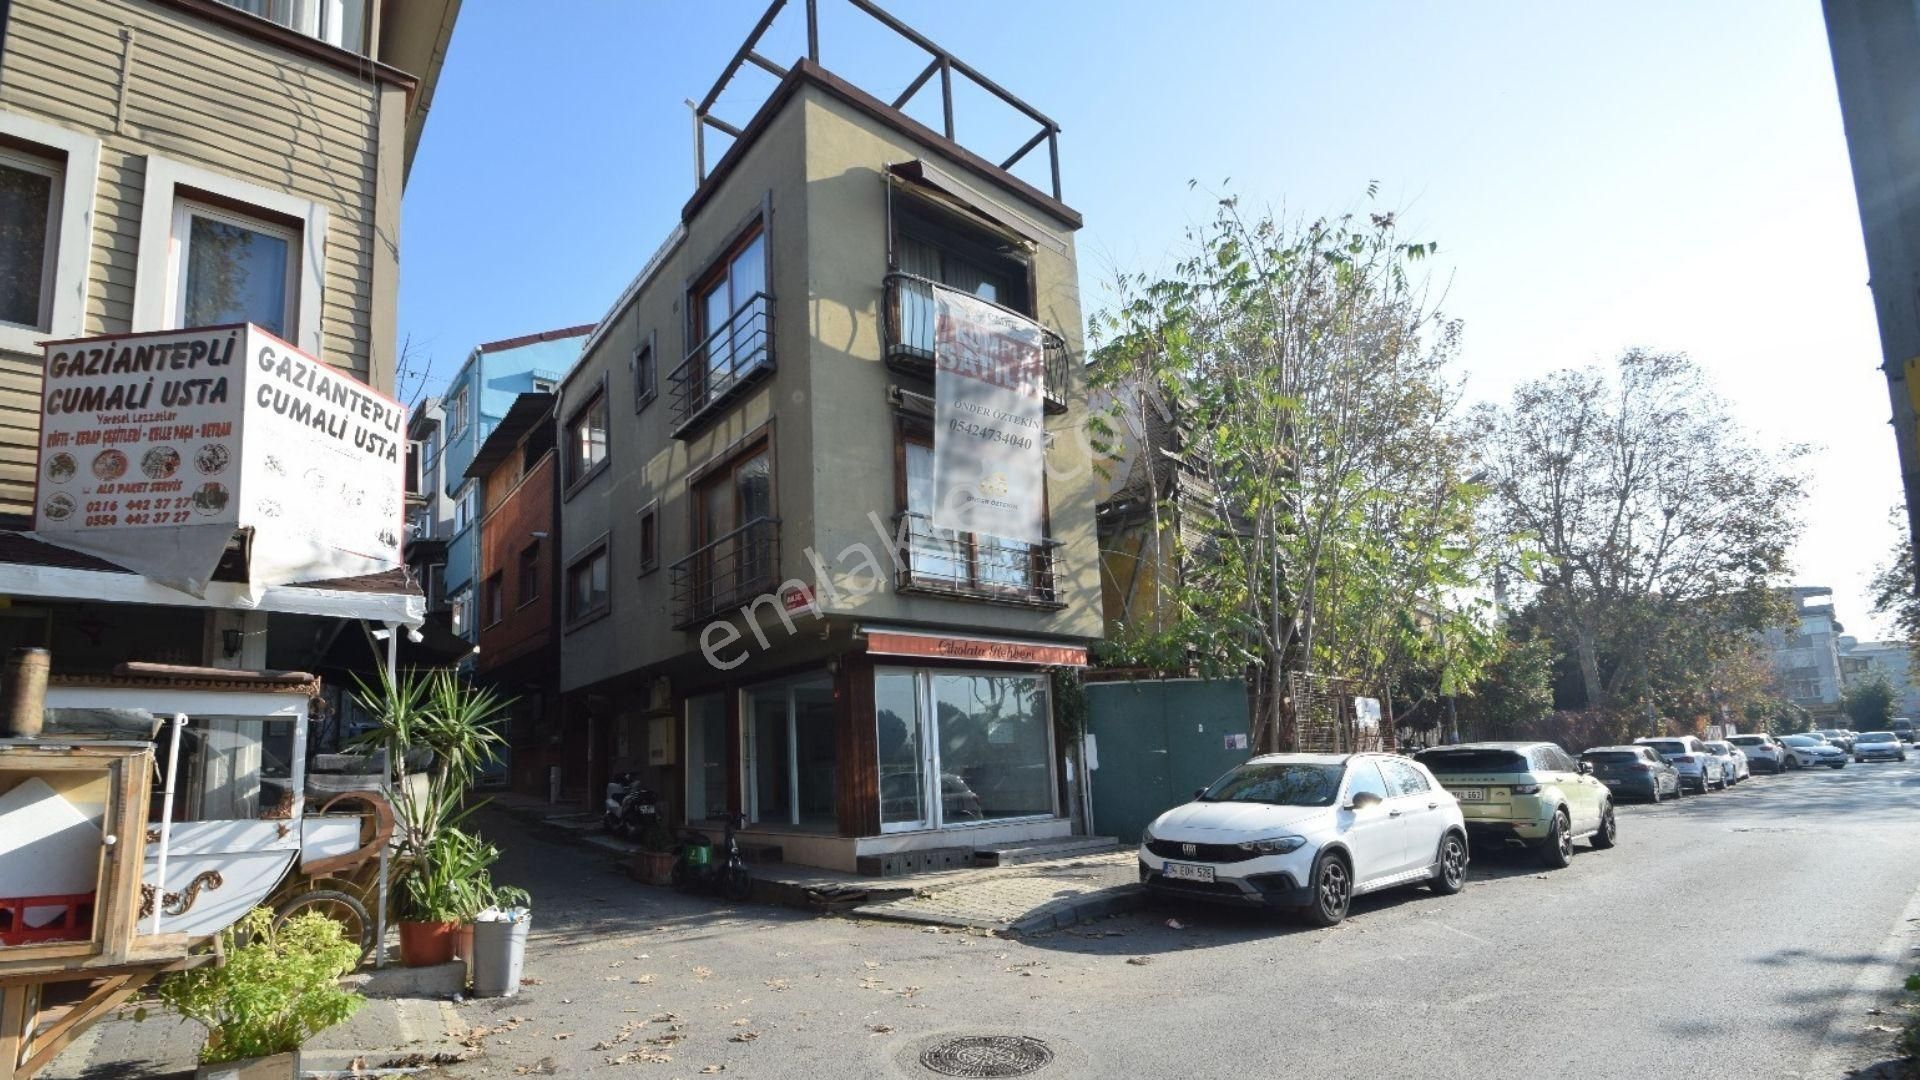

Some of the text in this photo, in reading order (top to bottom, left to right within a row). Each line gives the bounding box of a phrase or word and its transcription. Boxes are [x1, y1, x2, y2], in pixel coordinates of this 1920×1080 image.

[49, 331, 237, 378] GAZİANTEPLİ
[47, 376, 228, 414] CUMALİ USTA
[258, 346, 402, 433] GAZİANTEPLİ
[148, 427, 172, 442] KELLE
[257, 383, 349, 440] CUMALİ
[354, 426, 397, 464] USTA
[949, 418, 1032, 450] 05424734040
[96, 479, 184, 494] ALO PAKET SERVİS
[86, 501, 118, 513] 0216
[154, 498, 171, 510] 37
[174, 497, 192, 509] 27
[153, 512, 171, 524] 37
[173, 511, 191, 523] 27
